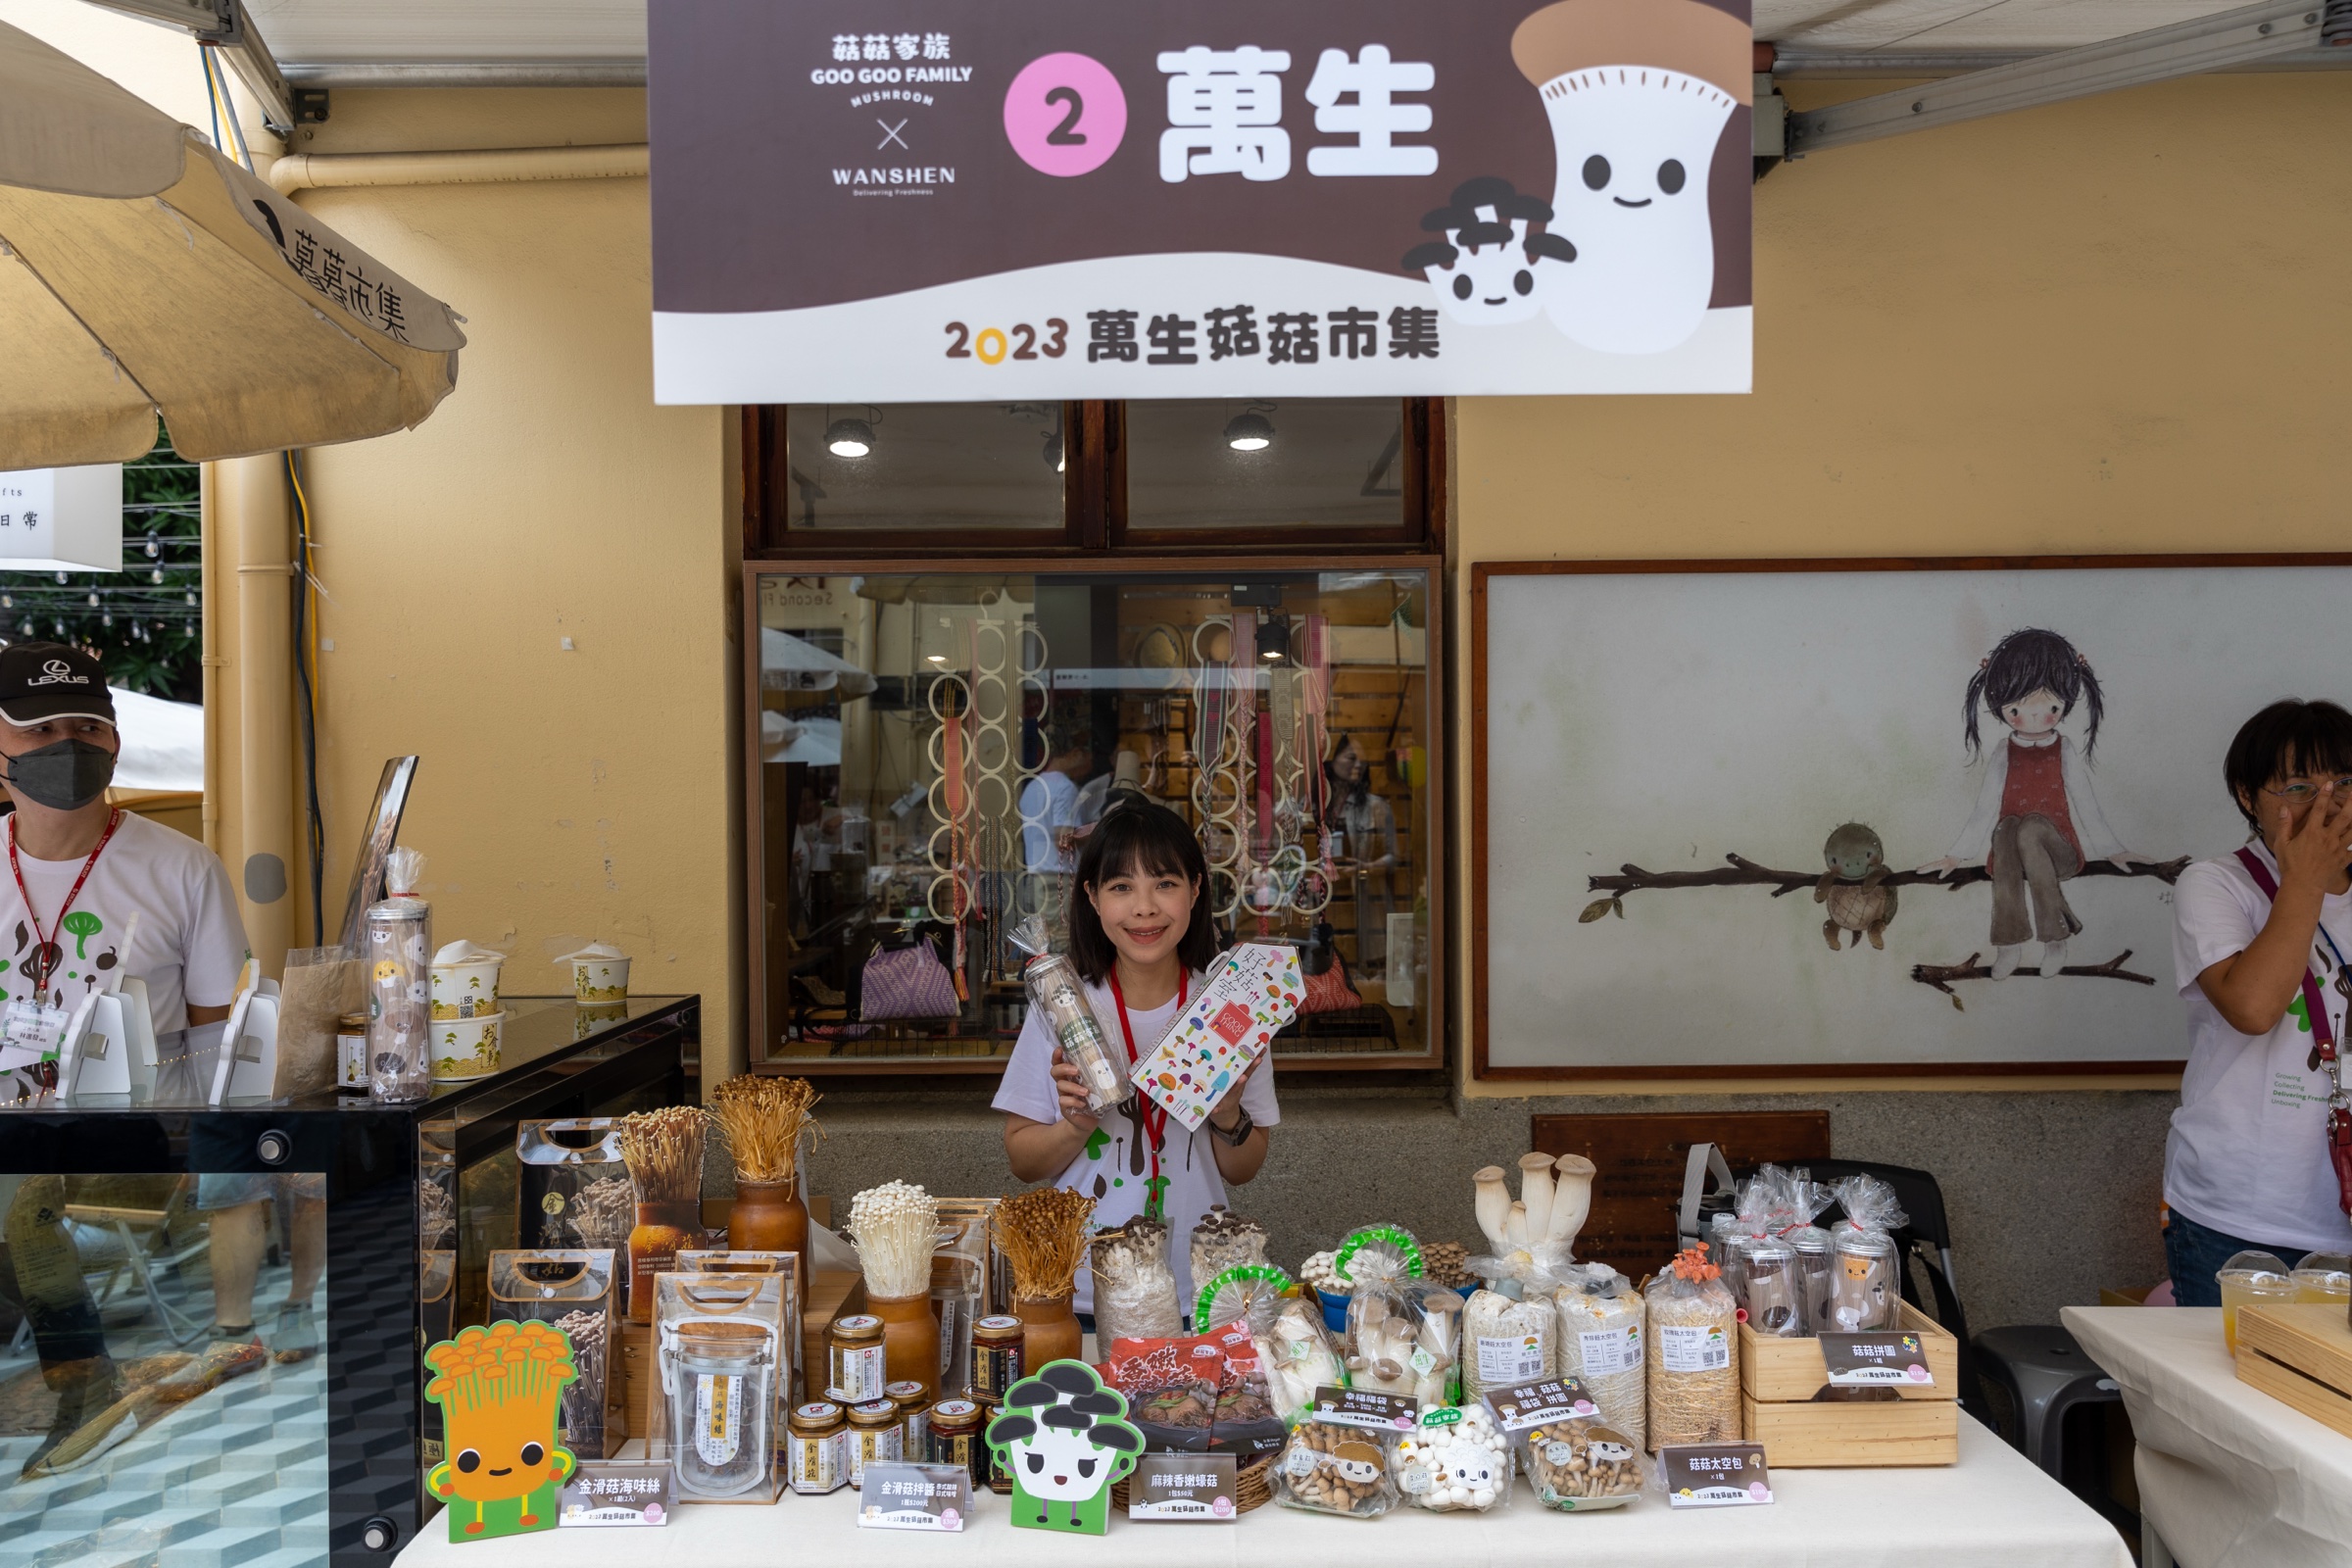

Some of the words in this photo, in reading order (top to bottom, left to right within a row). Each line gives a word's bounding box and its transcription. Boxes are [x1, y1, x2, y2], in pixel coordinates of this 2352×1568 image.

[832, 32, 951, 62] 菇菇家族
[810, 69, 855, 84] GOO
[858, 68, 902, 83] GOO
[906, 67, 972, 82] FAMILY
[851, 89, 934, 108] MUSHROOM
[1045, 86, 1088, 146] 2
[1156, 44, 1439, 183] 萬生
[832, 167, 956, 185] WANSHEN
[945, 317, 1068, 366] 2023
[1086, 304, 1440, 366] 萬生菇菇市集
[1, 511, 37, 530] 日常
[27, 675, 89, 686] LEXUS
[1220, 1018, 1240, 1037] THING
[1222, 1012, 1245, 1034] GOOD
[2276, 1072, 2301, 1082] Growing
[2275, 1081, 2305, 1092] Collecting
[2272, 1099, 2300, 1108] Unboxing
[2273, 1090, 2306, 1101] Delivering
[2308, 1095, 2340, 1104] Freshnss
[1852, 1345, 1896, 1356] 菇菇拼圖
[1514, 1388, 1536, 1398] 幸福
[1540, 1383, 1561, 1394] 菇菇
[1519, 1398, 1543, 1409] 福袋
[1545, 1393, 1568, 1404] 拼圖
[1690, 1457, 1742, 1470] 菇菇太空包
[578, 1478, 661, 1494] 金滑菇海味絲
[881, 1481, 935, 1496] 金滑菇拌醬
[1151, 1474, 1218, 1488] 麻辣香嫩蠔菇
